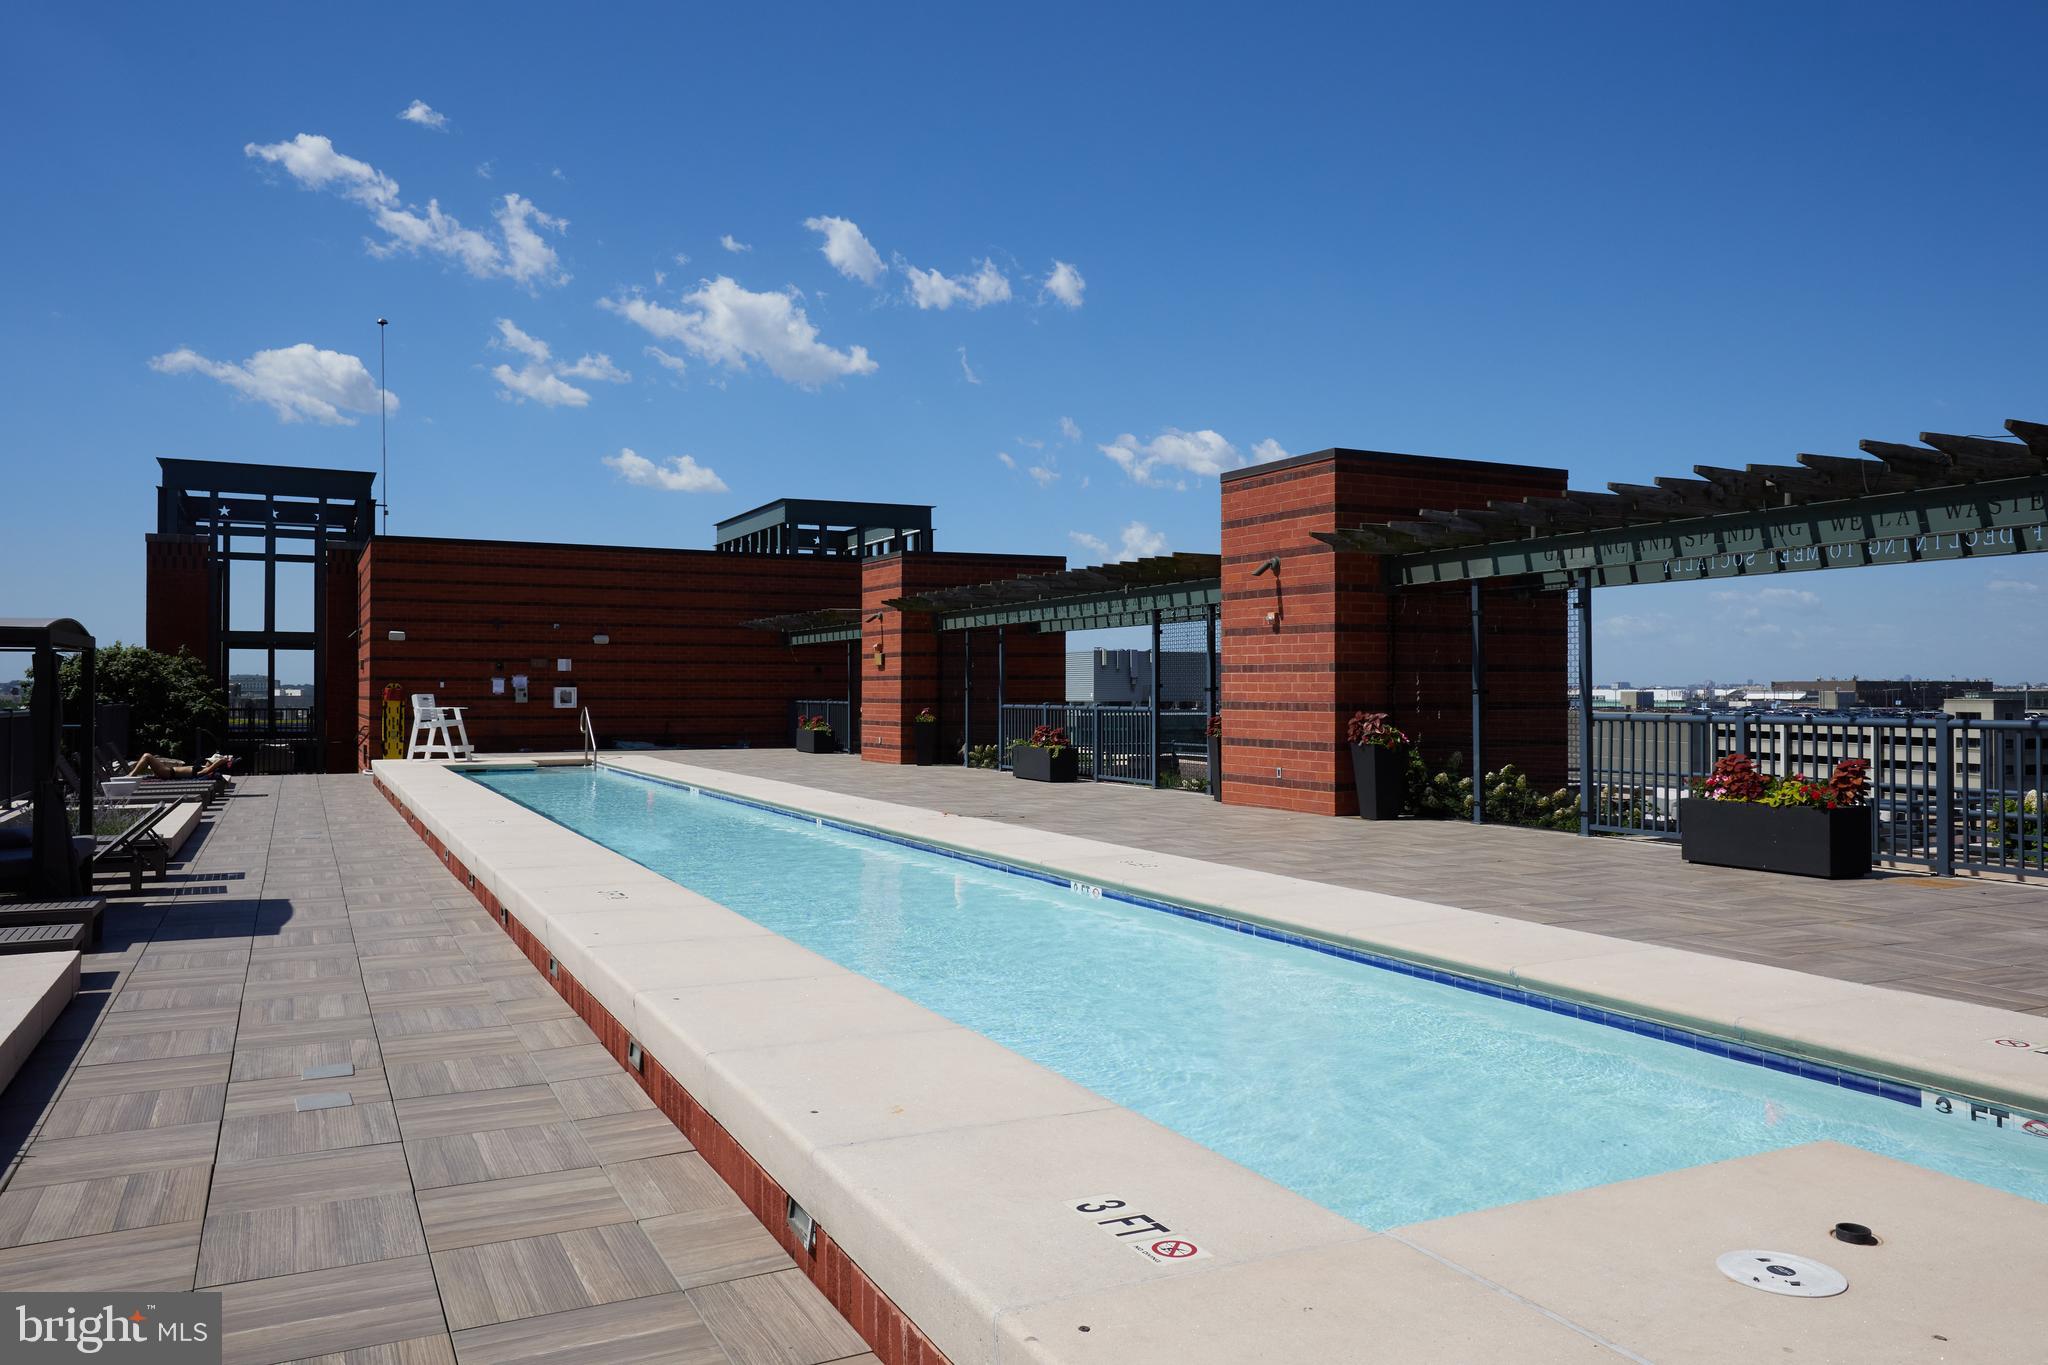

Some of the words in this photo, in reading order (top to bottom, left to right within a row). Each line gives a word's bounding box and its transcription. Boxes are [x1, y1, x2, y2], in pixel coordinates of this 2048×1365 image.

[1971, 1103, 2010, 1128] FT
[1076, 1200, 1126, 1213] 3
[1097, 1214, 1171, 1237] FT
